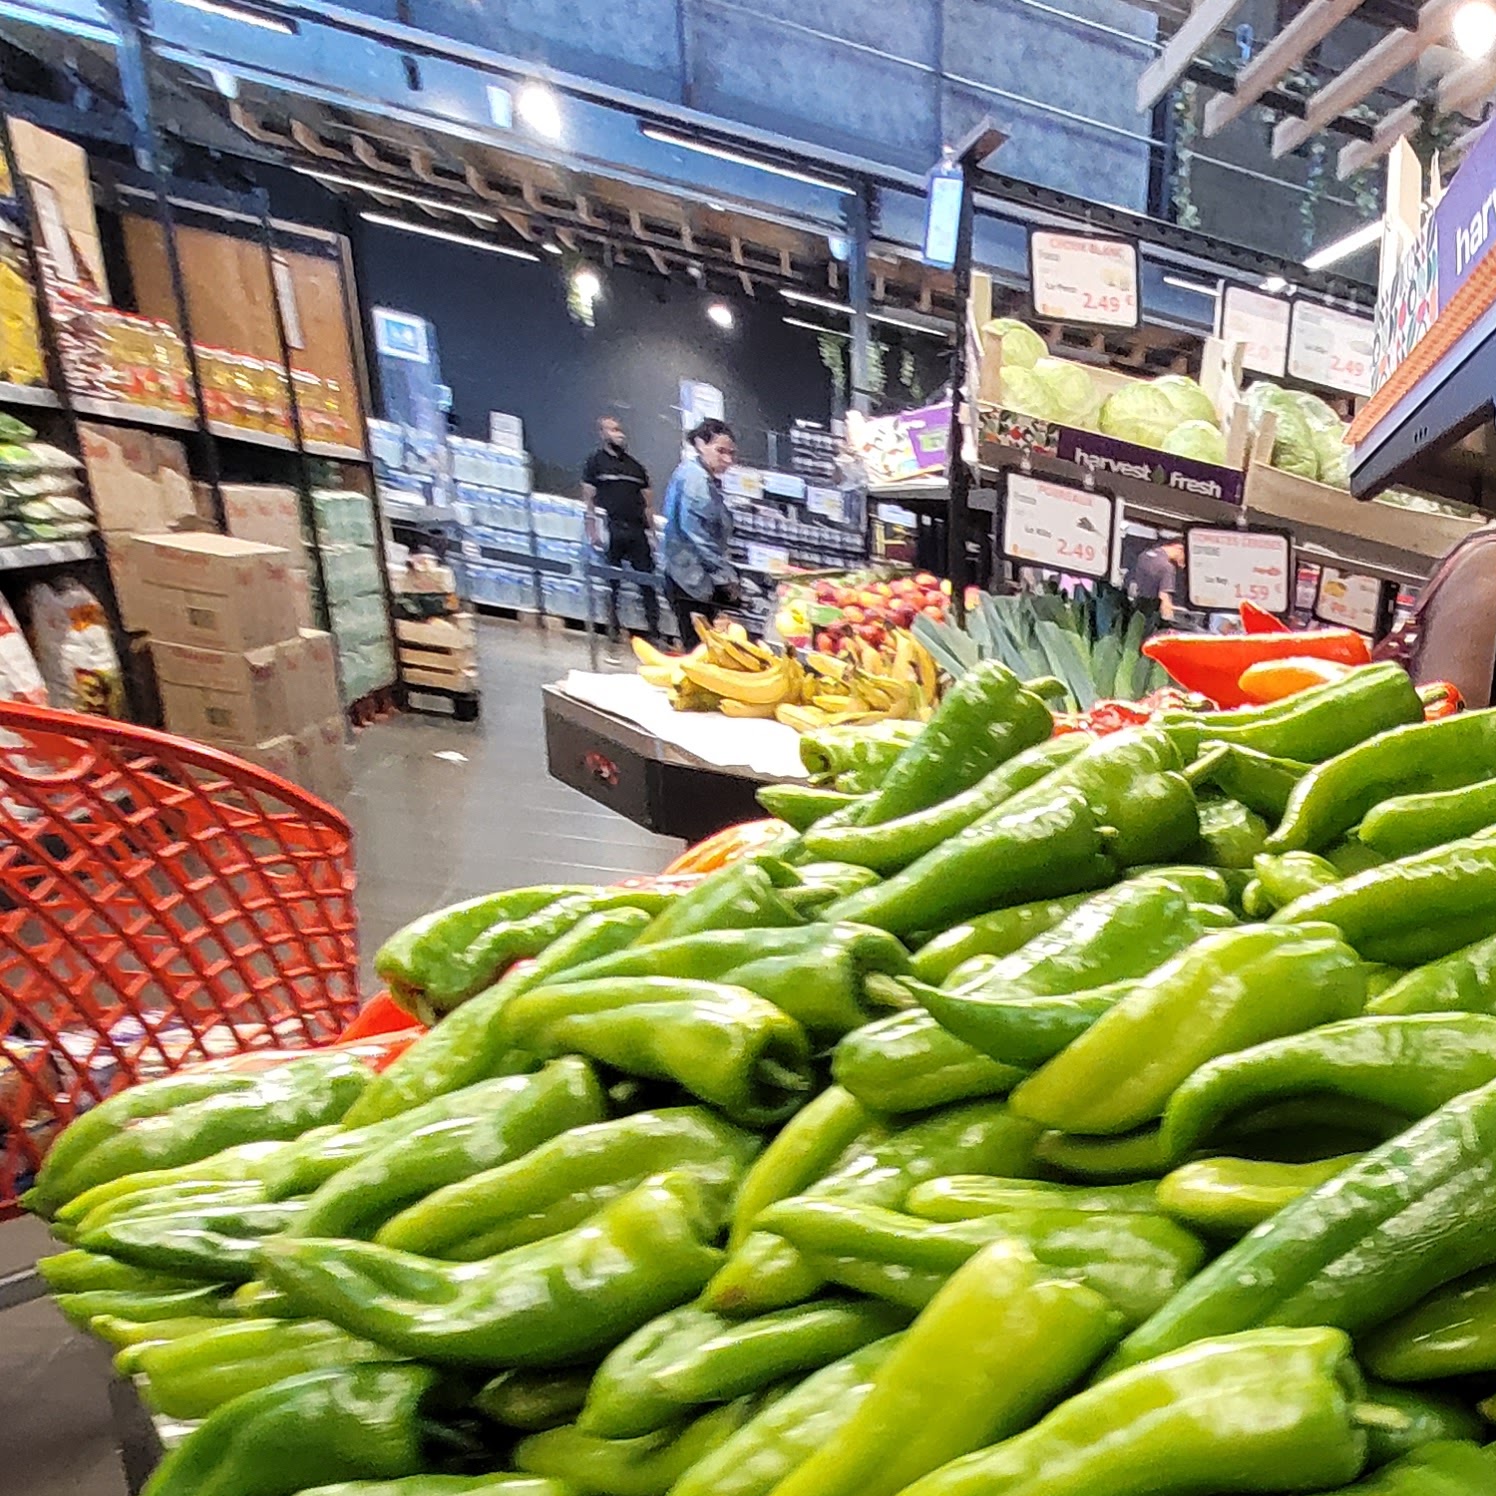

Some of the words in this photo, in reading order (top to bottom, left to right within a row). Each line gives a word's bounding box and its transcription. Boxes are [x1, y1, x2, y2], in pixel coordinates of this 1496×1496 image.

[1082, 292, 1120, 313] 2.49
[1074, 447, 1152, 483] harvest
[1168, 471, 1223, 500] fresh
[1057, 538, 1096, 562] 2.49
